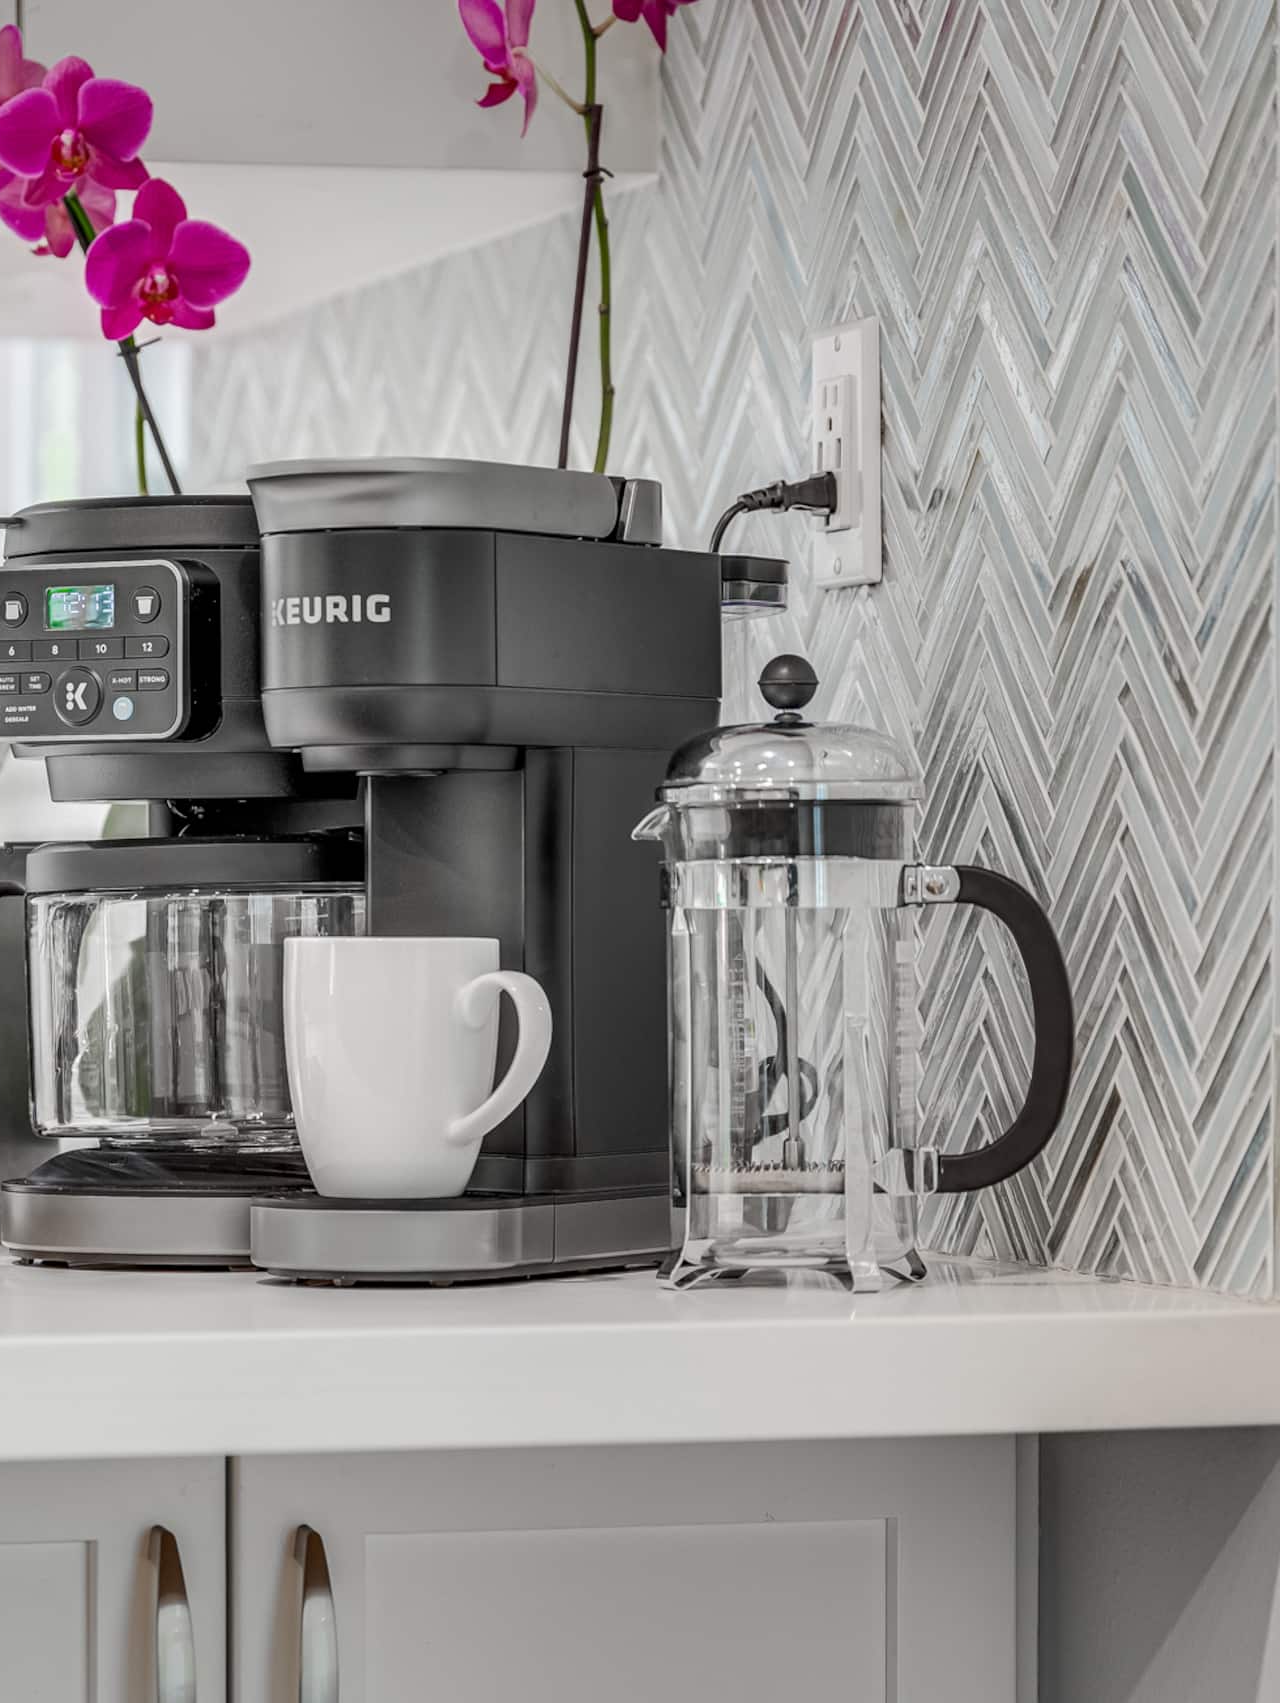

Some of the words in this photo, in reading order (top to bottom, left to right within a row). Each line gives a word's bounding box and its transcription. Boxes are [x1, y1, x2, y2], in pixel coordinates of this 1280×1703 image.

[271, 593, 392, 627] KEURIG
[8, 646, 16, 656] 6
[51, 645, 59, 655] 8
[95, 643, 108, 654] 10
[141, 642, 153, 652] 12
[139, 675, 166, 683] STRONG
